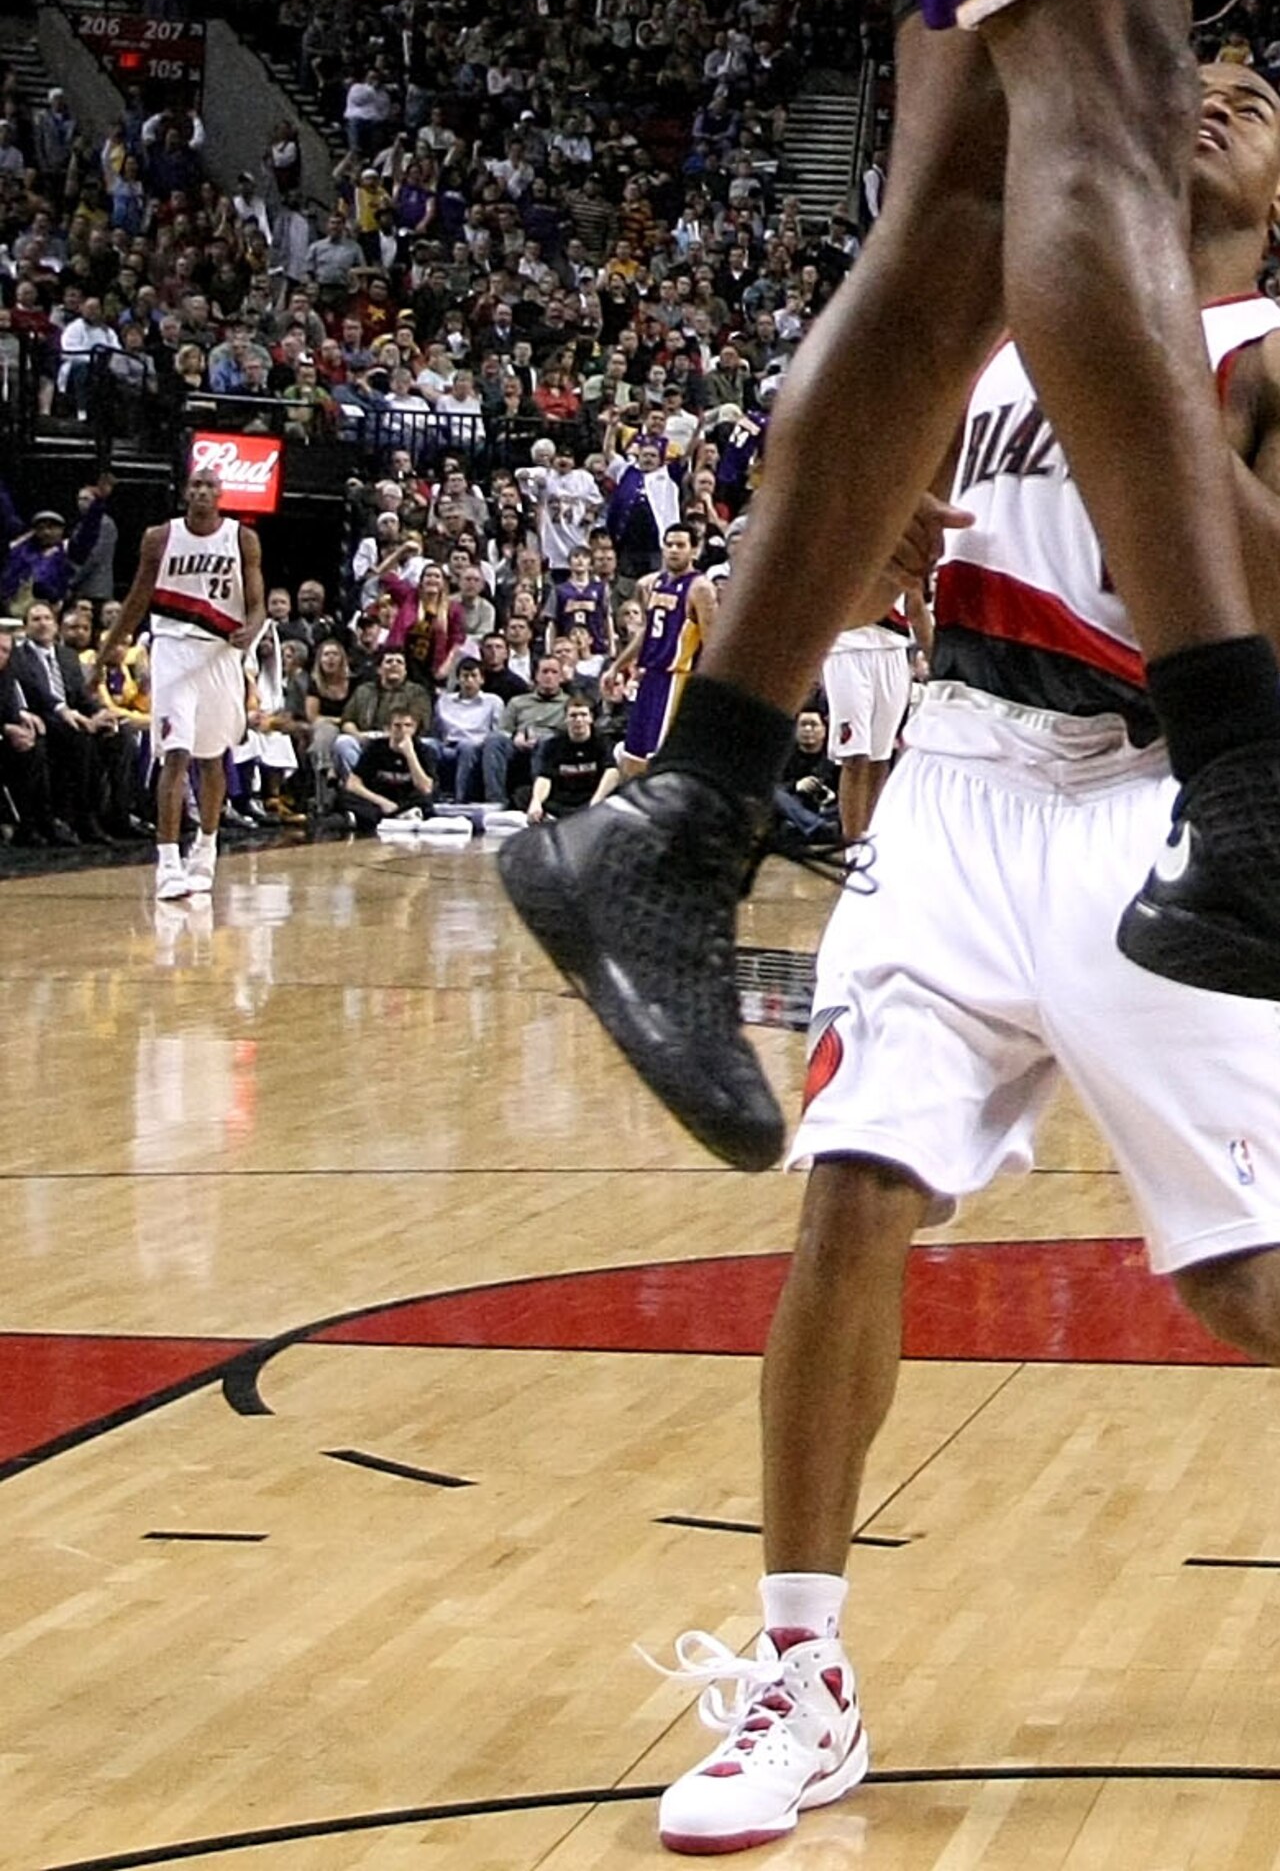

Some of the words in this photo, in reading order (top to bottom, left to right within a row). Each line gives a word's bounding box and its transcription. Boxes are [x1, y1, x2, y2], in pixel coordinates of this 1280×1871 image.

[143, 20, 184, 41] 207
[208, 577, 232, 600] 25
[651, 608, 667, 638] 5
